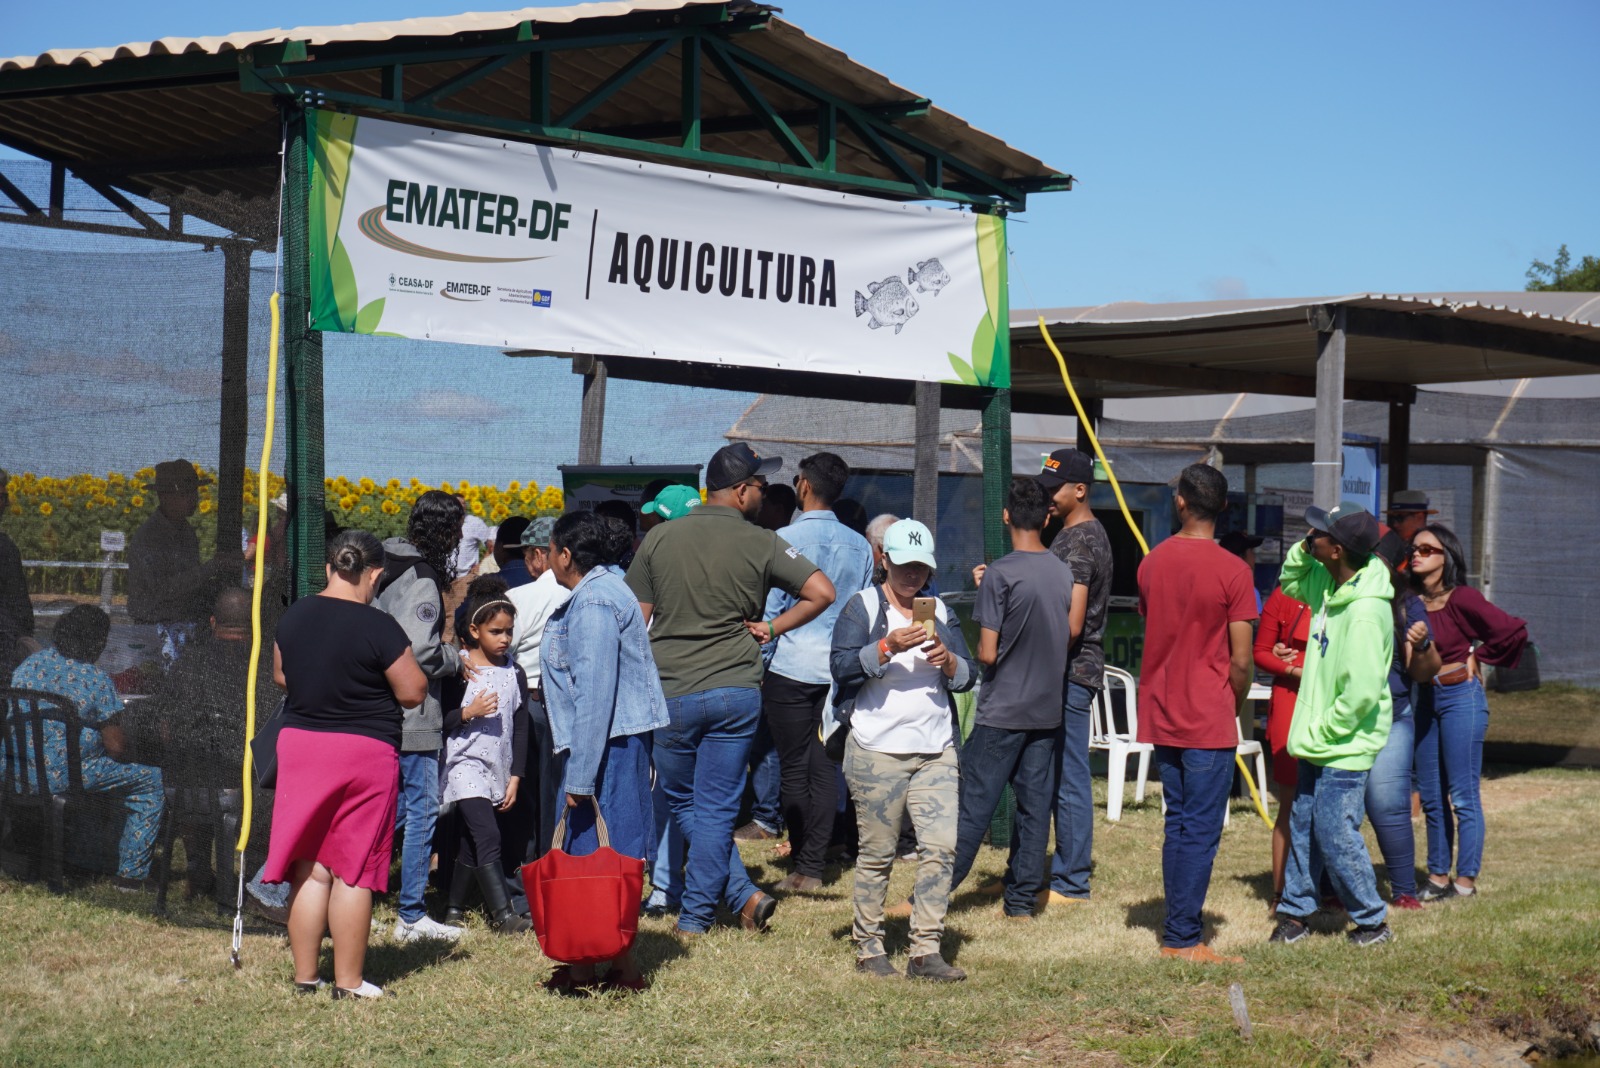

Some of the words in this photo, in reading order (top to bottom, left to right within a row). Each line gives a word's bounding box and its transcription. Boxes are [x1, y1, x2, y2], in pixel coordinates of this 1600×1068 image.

[386, 179, 572, 242] EMATER-DF
[608, 232, 837, 308] AQUICULTURA
[398, 276, 434, 289] CEASA-DF
[446, 281, 492, 296] EMATER-DF
[1343, 475, 1370, 495] iscicultura
[908, 531, 922, 546] NY
